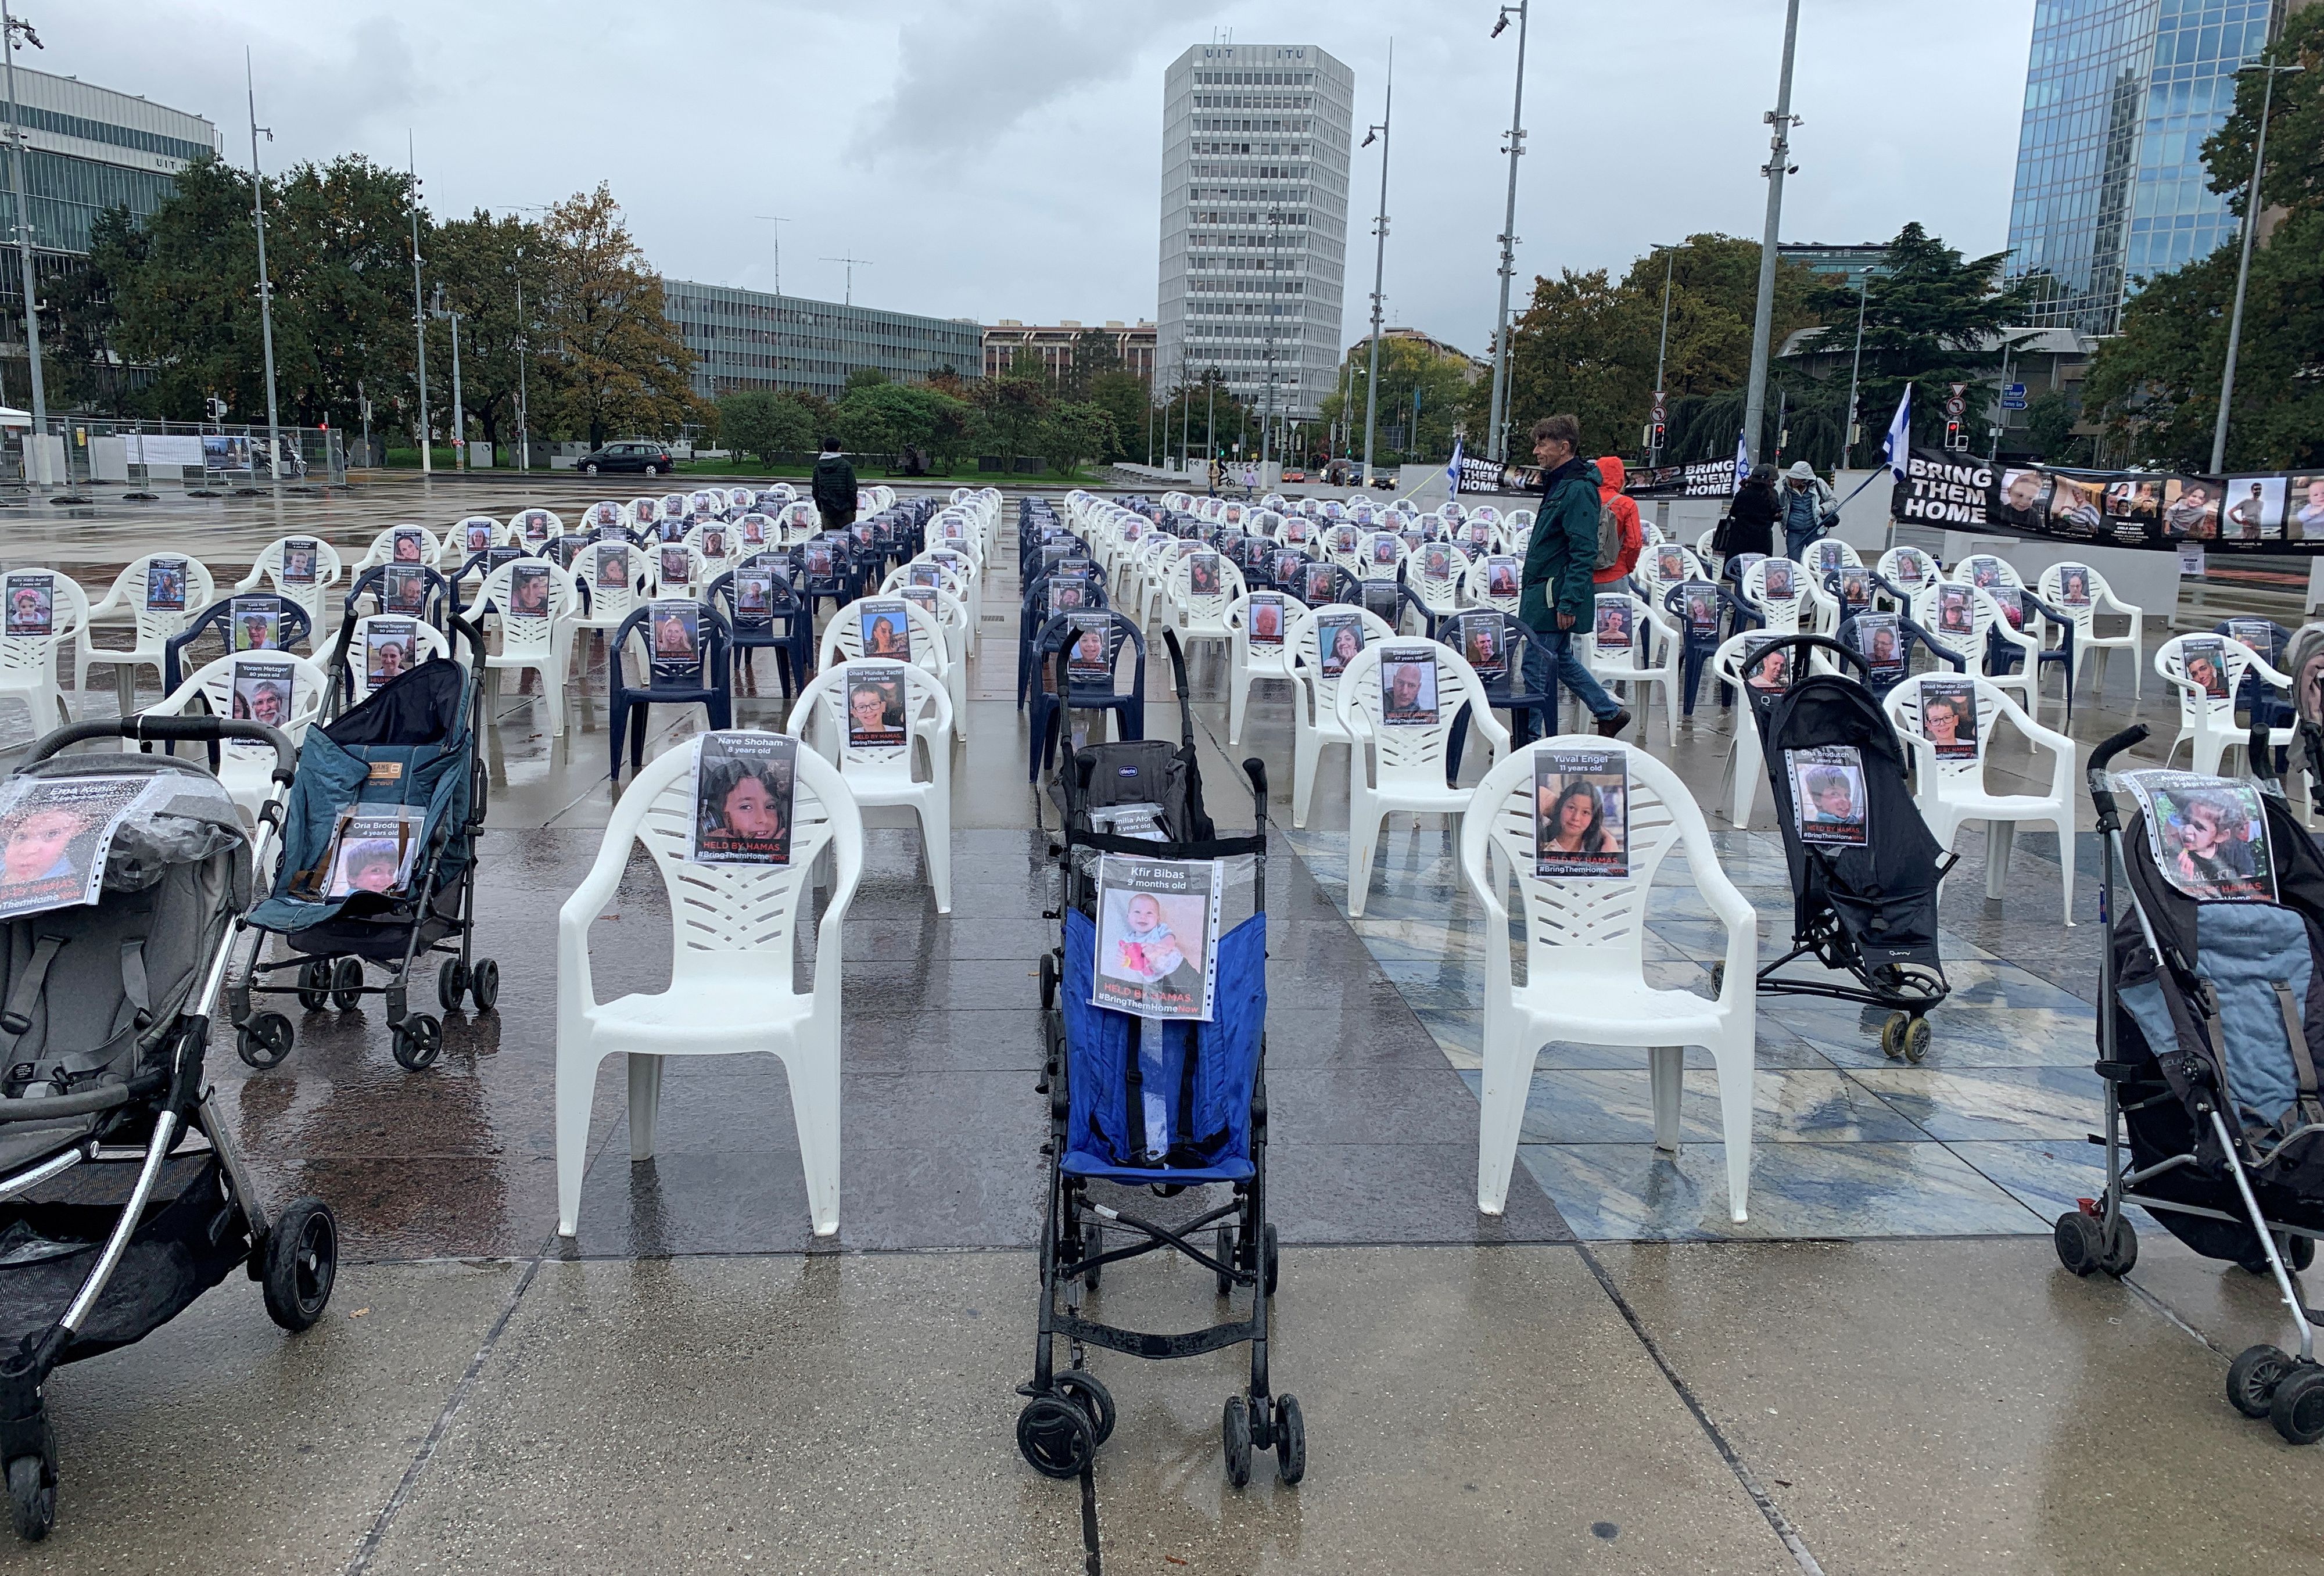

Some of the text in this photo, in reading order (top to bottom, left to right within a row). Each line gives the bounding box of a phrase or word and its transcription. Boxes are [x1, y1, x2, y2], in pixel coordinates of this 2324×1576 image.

[1206, 49, 1303, 59] UIT ITU
[156, 158, 176, 170] UIT
[1462, 458, 1504, 472] BRING
[1685, 459, 1735, 475] BRING
[1463, 469, 1498, 482] THEM
[1685, 472, 1732, 485] THEM
[1909, 458, 1992, 487] BRING
[1460, 479, 1499, 491] HOME
[1685, 483, 1731, 496] HOME
[1911, 478, 1987, 506] THEM
[1905, 497, 1987, 524] HOME
[1761, 696, 1770, 706] Q
[718, 738, 784, 746] Nave Shoham
[1553, 755, 1608, 765] Yuval Engel
[50, 787, 78, 796] Ema
[1114, 816, 1134, 825] milia
[703, 841, 727, 849] HELD
[731, 841, 743, 850] BY
[1131, 866, 1185, 879] Kfir Bibas
[1135, 880, 1170, 889] months
[1172, 881, 1186, 889] old
[1104, 983, 1131, 996] HELD
[1098, 992, 1200, 1014] #BringThemHomeNow
